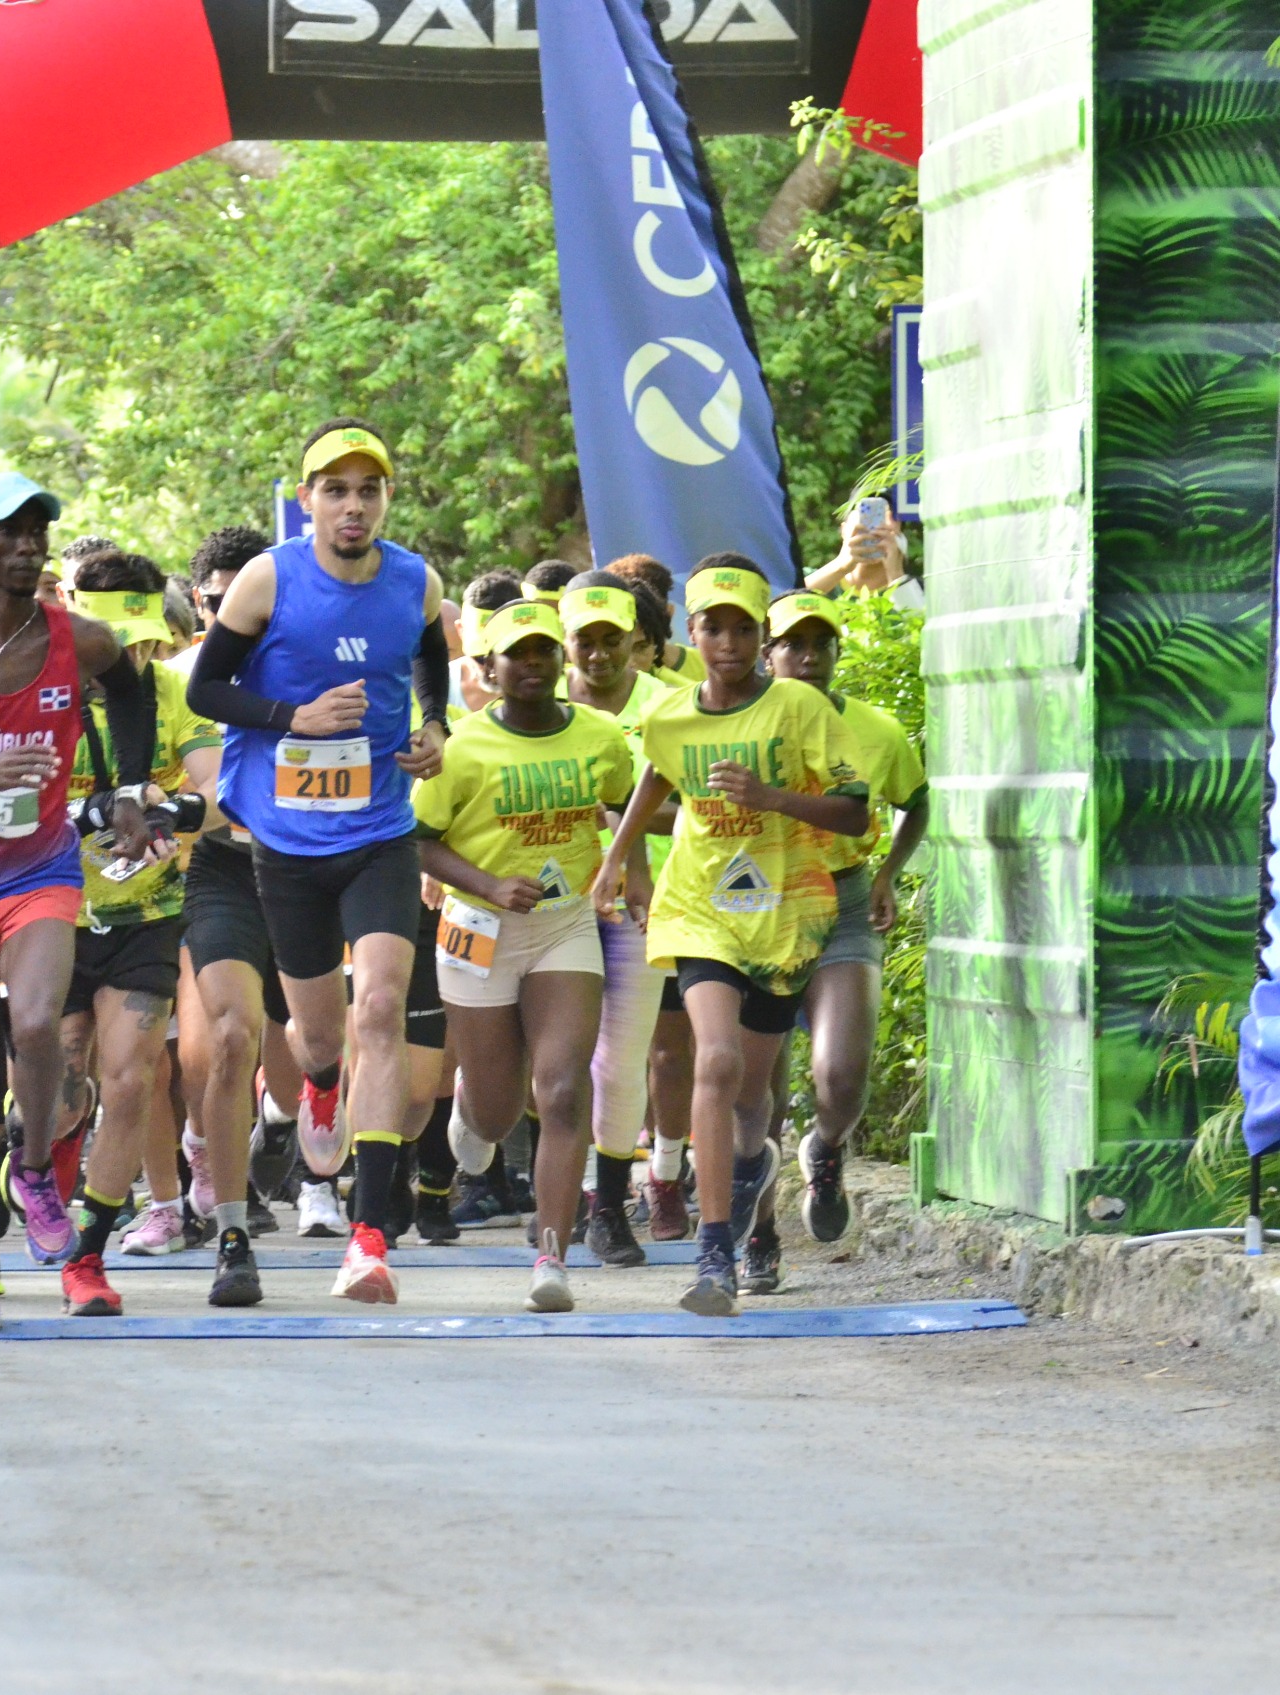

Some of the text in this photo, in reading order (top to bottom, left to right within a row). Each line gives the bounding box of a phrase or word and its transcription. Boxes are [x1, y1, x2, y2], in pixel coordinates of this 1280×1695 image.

[284, 0, 799, 48] SALA
[626, 66, 718, 297] CE
[296, 769, 352, 798] 210
[494, 756, 599, 816] JUNGLE
[445, 925, 474, 961] 01
